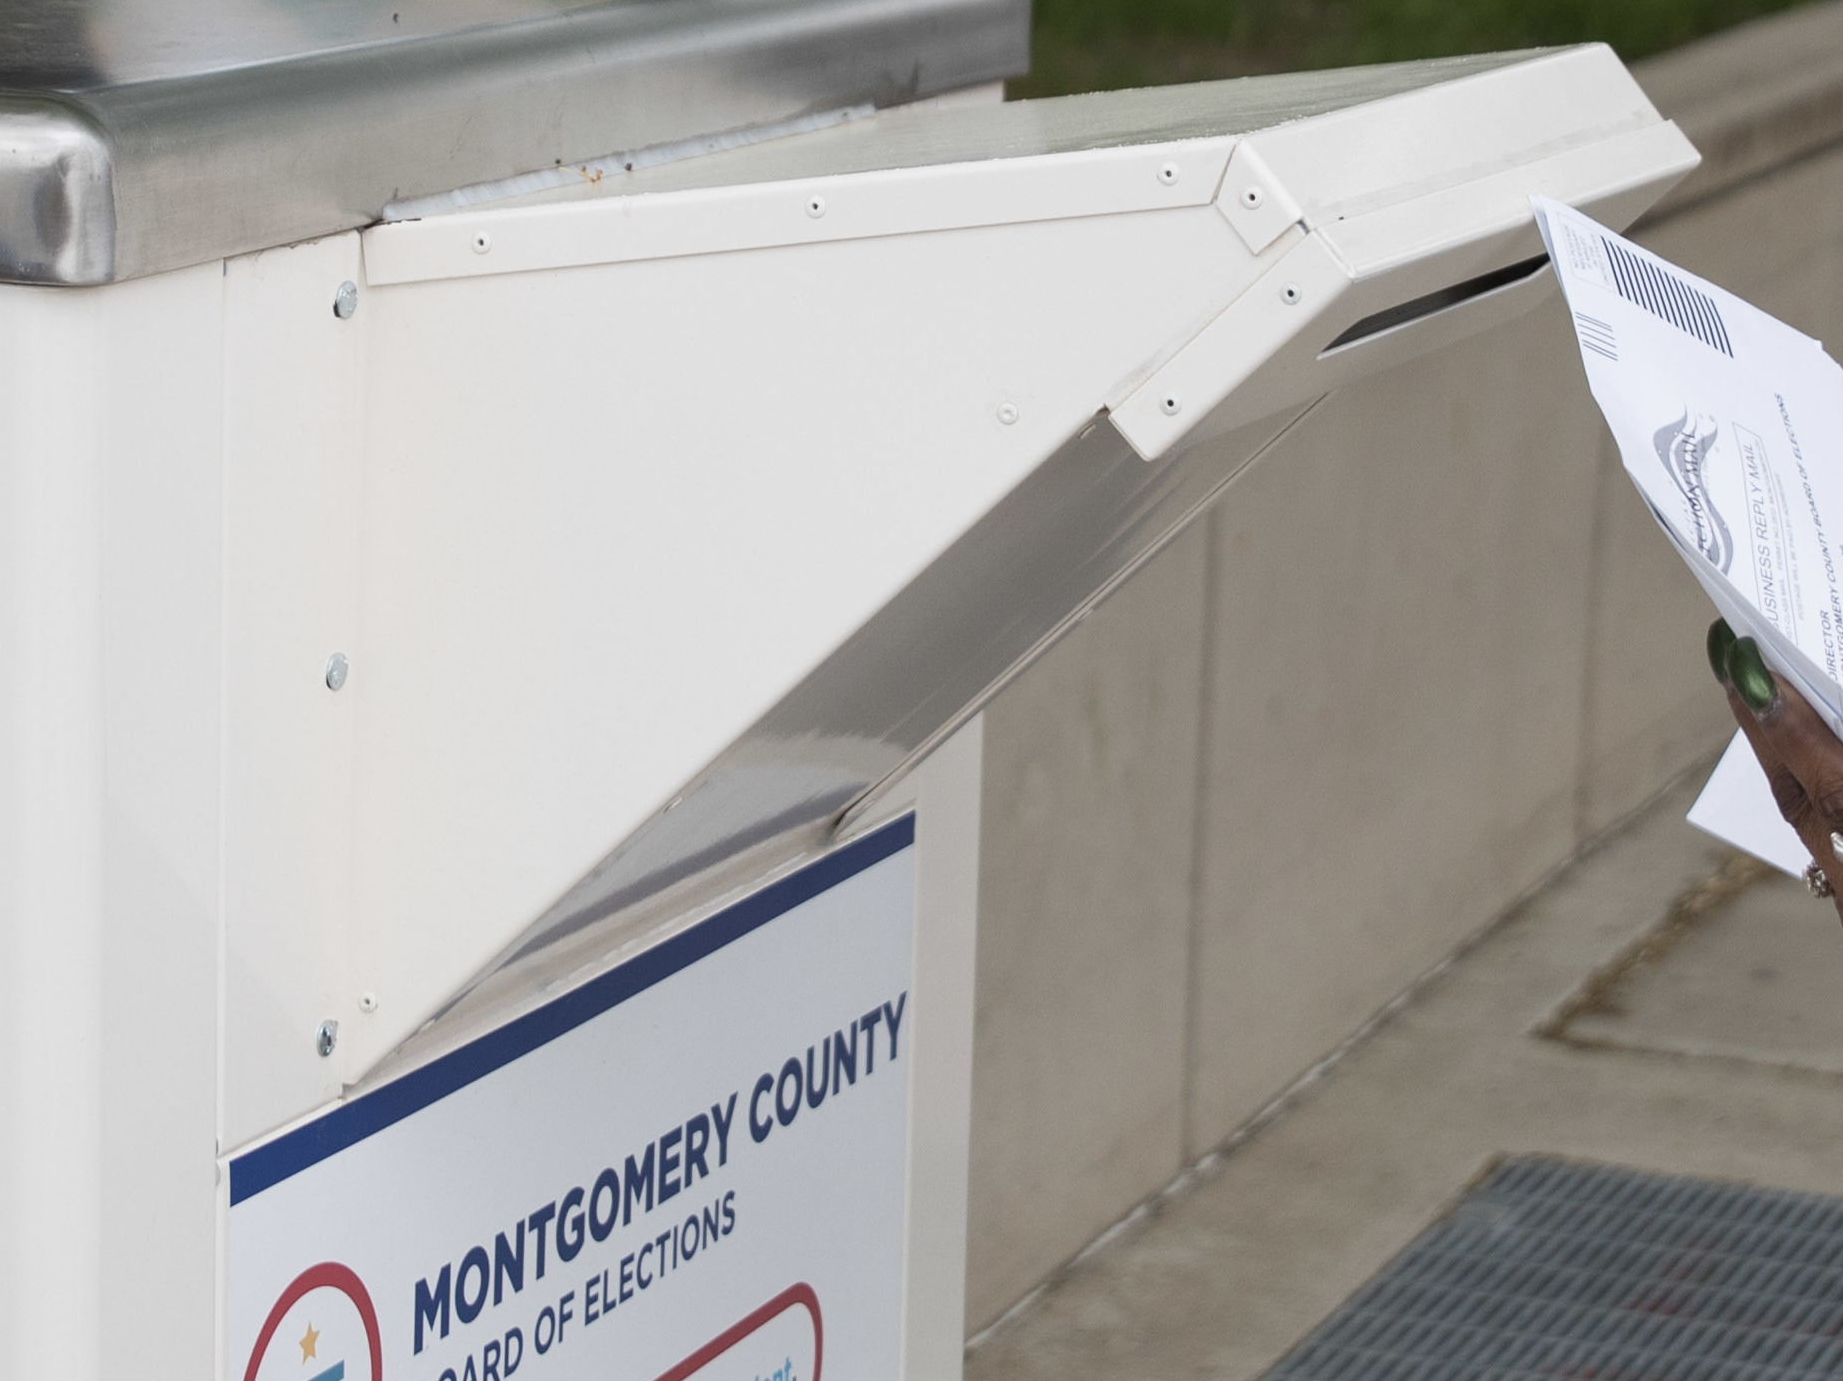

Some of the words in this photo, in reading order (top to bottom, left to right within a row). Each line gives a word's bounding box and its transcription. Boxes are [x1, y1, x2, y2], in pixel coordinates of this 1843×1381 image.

[1774, 392, 1803, 460] ELECTIONS
[1743, 442, 1760, 479] MAIL
[1797, 461, 1807, 479] OF
[1750, 481, 1769, 540] REPLY
[1803, 482, 1822, 527] BOARD
[1817, 529, 1836, 583] COUNTY
[1758, 544, 1779, 628] USINESS
[412, 1091, 739, 1356] MONTGOMERY
[748, 991, 908, 1145] COUNTY
[533, 1292, 576, 1357] OF
[583, 1189, 737, 1327] ELECTIONS
